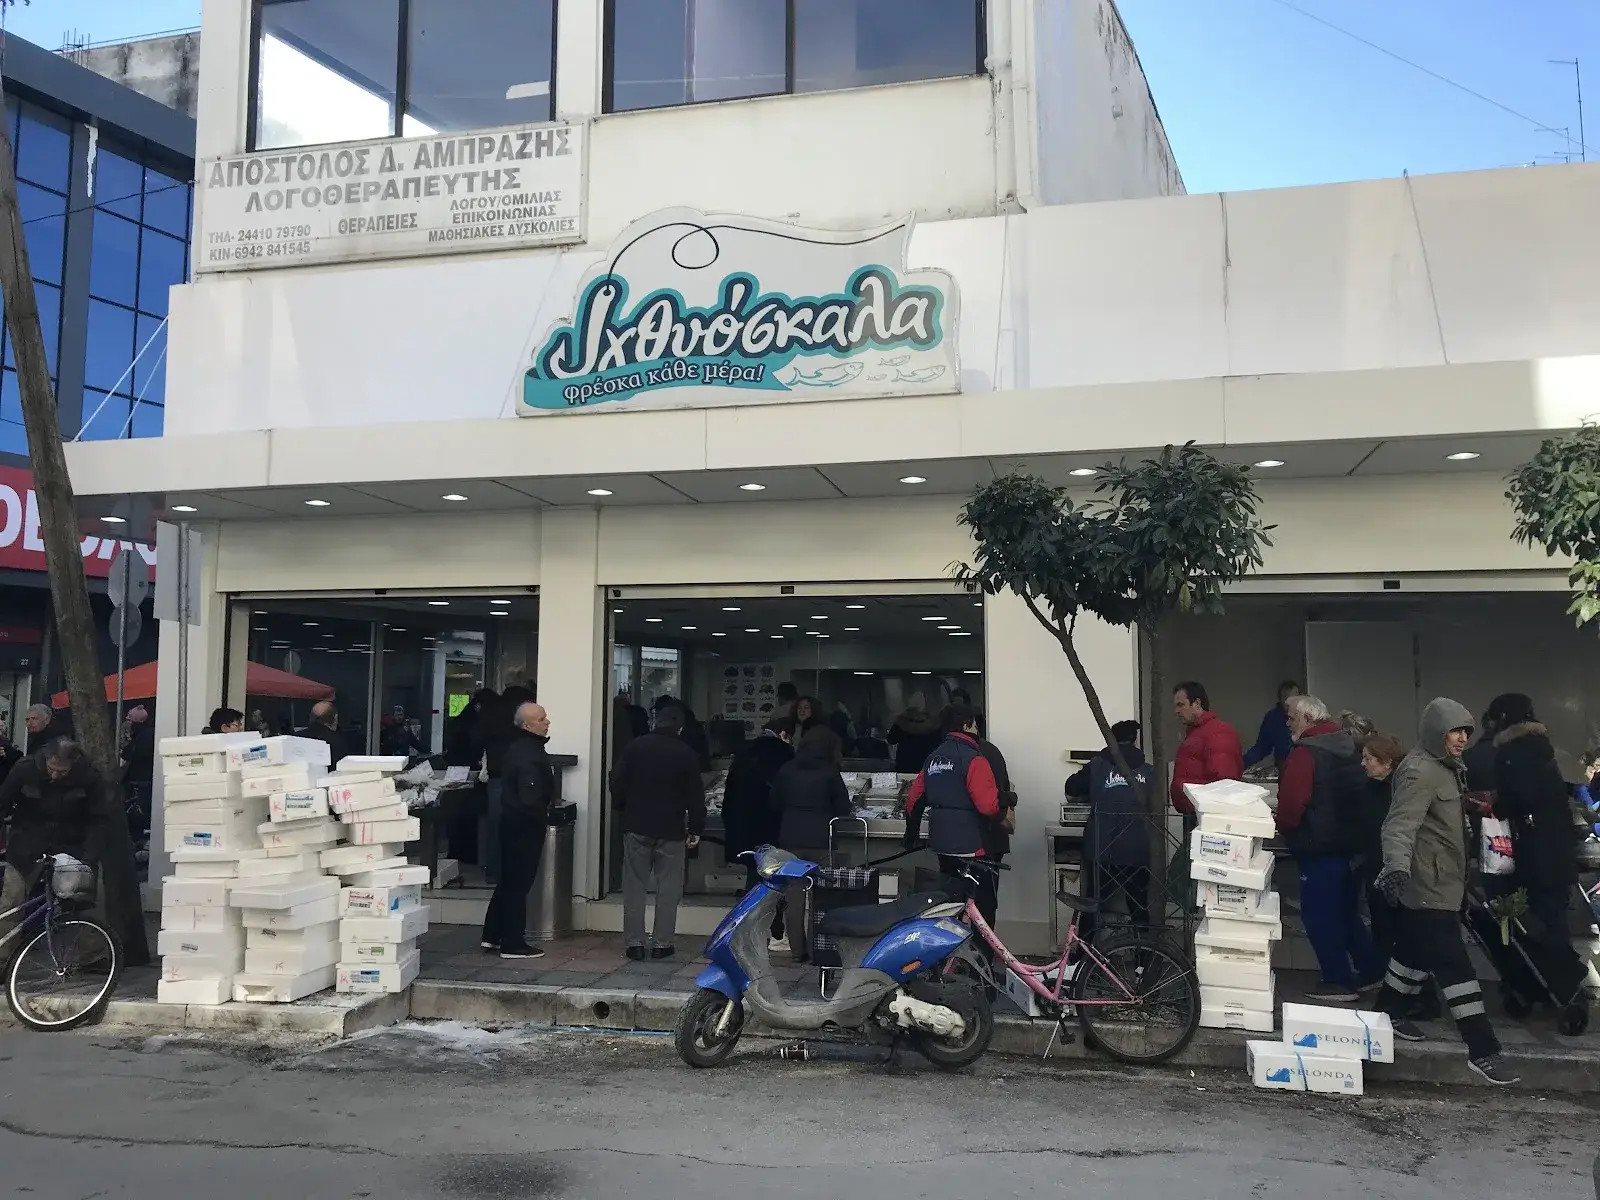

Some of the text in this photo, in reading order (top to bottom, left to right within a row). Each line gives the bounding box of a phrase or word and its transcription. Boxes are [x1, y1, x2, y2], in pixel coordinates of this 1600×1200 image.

[208, 128, 572, 189] ΑΠΟΣΤΟΛΟΣ Δ. ΑΜΠΡΑΖΗΣ
[245, 167, 521, 213] ΛΟΓΟΘΕΡΑΠΕΥΤΗΣ
[337, 212, 418, 235] ΘΕΡΑΠΕΙΕΣ
[452, 204, 557, 225] ΕΠΙΚΟΙΝΩΝΙΑΣ
[237, 227, 273, 242] 24410
[276, 224, 311, 239] 79790
[428, 219, 575, 243] ΜΑΘΗΣΙΑΚΕΣ ΔΥΣΚΟΛΙΕΣ
[266, 241, 311, 257] 841545
[563, 360, 765, 404] φρέσκα κάθε μέρα!
[1290, 1067, 1353, 1080] SELONDA
